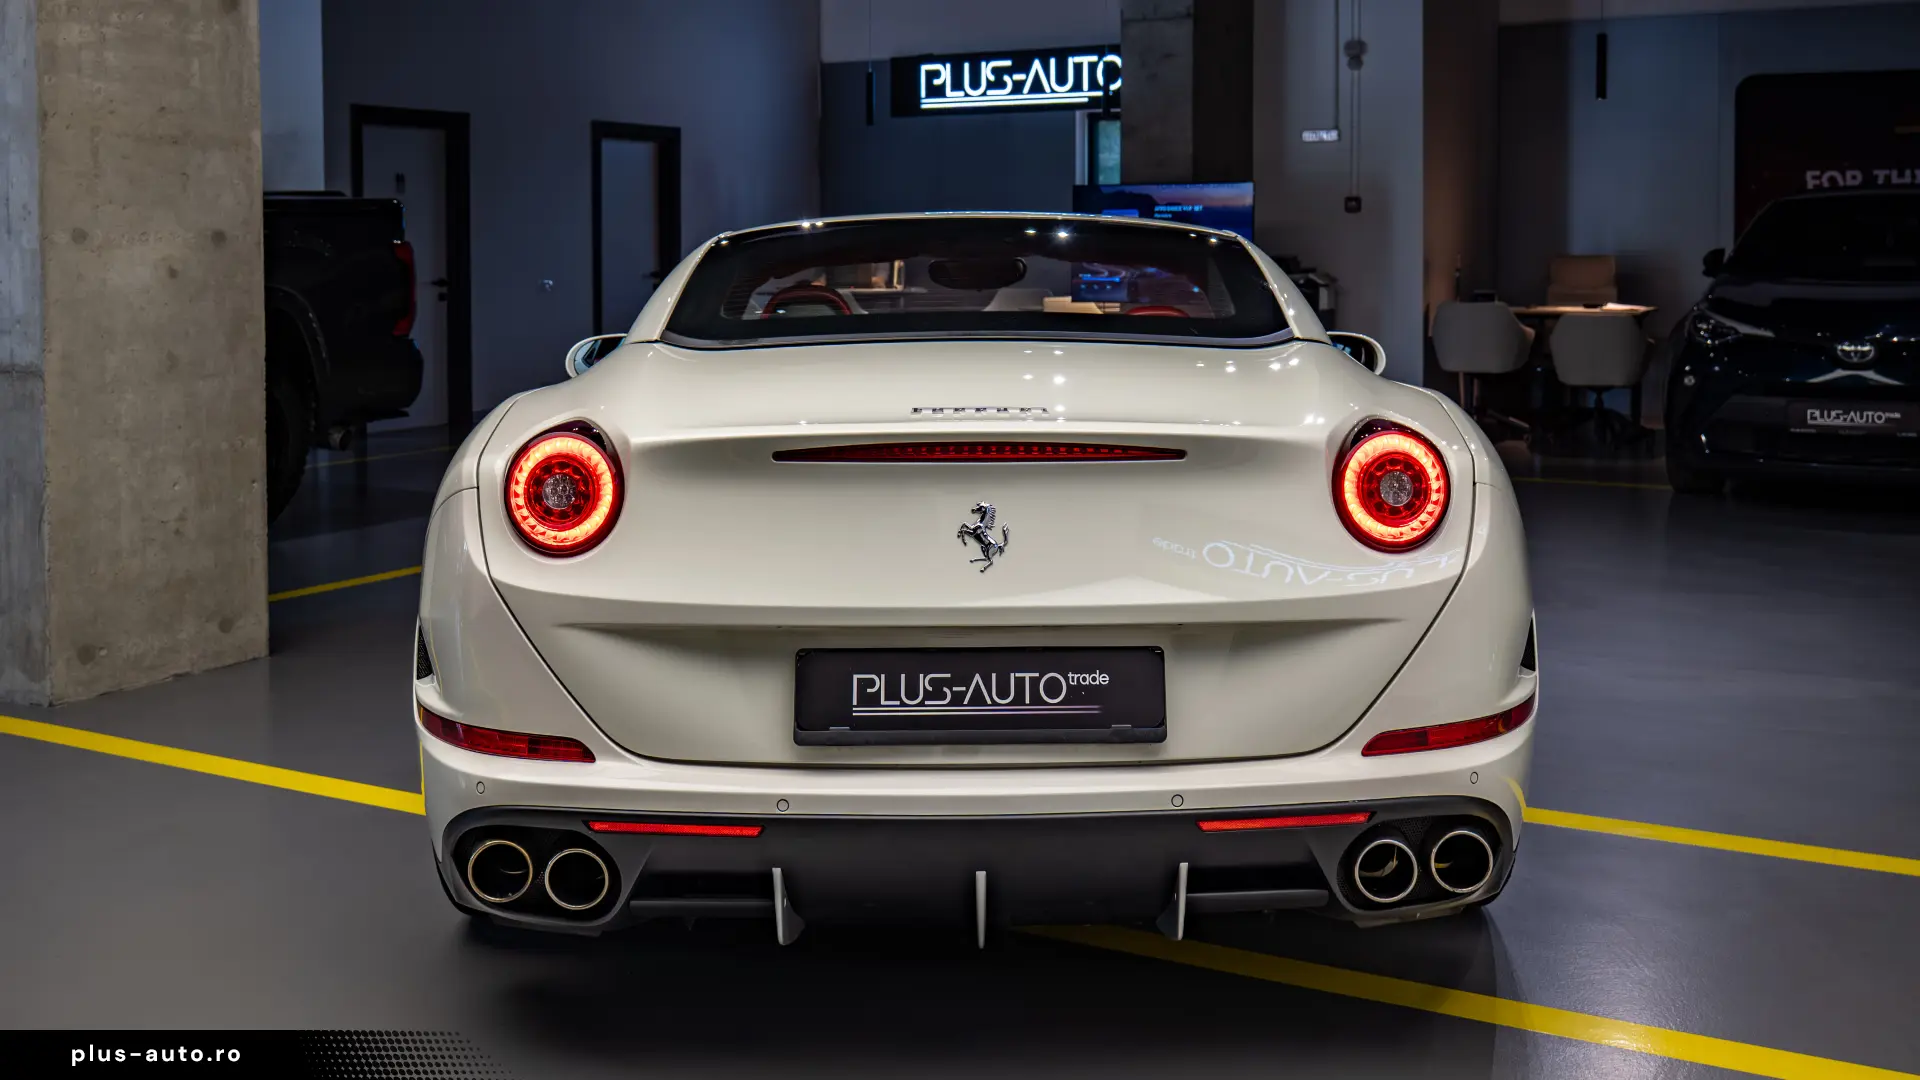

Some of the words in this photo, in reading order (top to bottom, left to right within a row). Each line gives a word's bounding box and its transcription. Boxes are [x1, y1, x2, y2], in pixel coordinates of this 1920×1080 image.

[919, 54, 1122, 99] PLUS-AUTO
[852, 672, 1068, 706] PLUS-AUTO
[1067, 669, 1110, 686] trade
